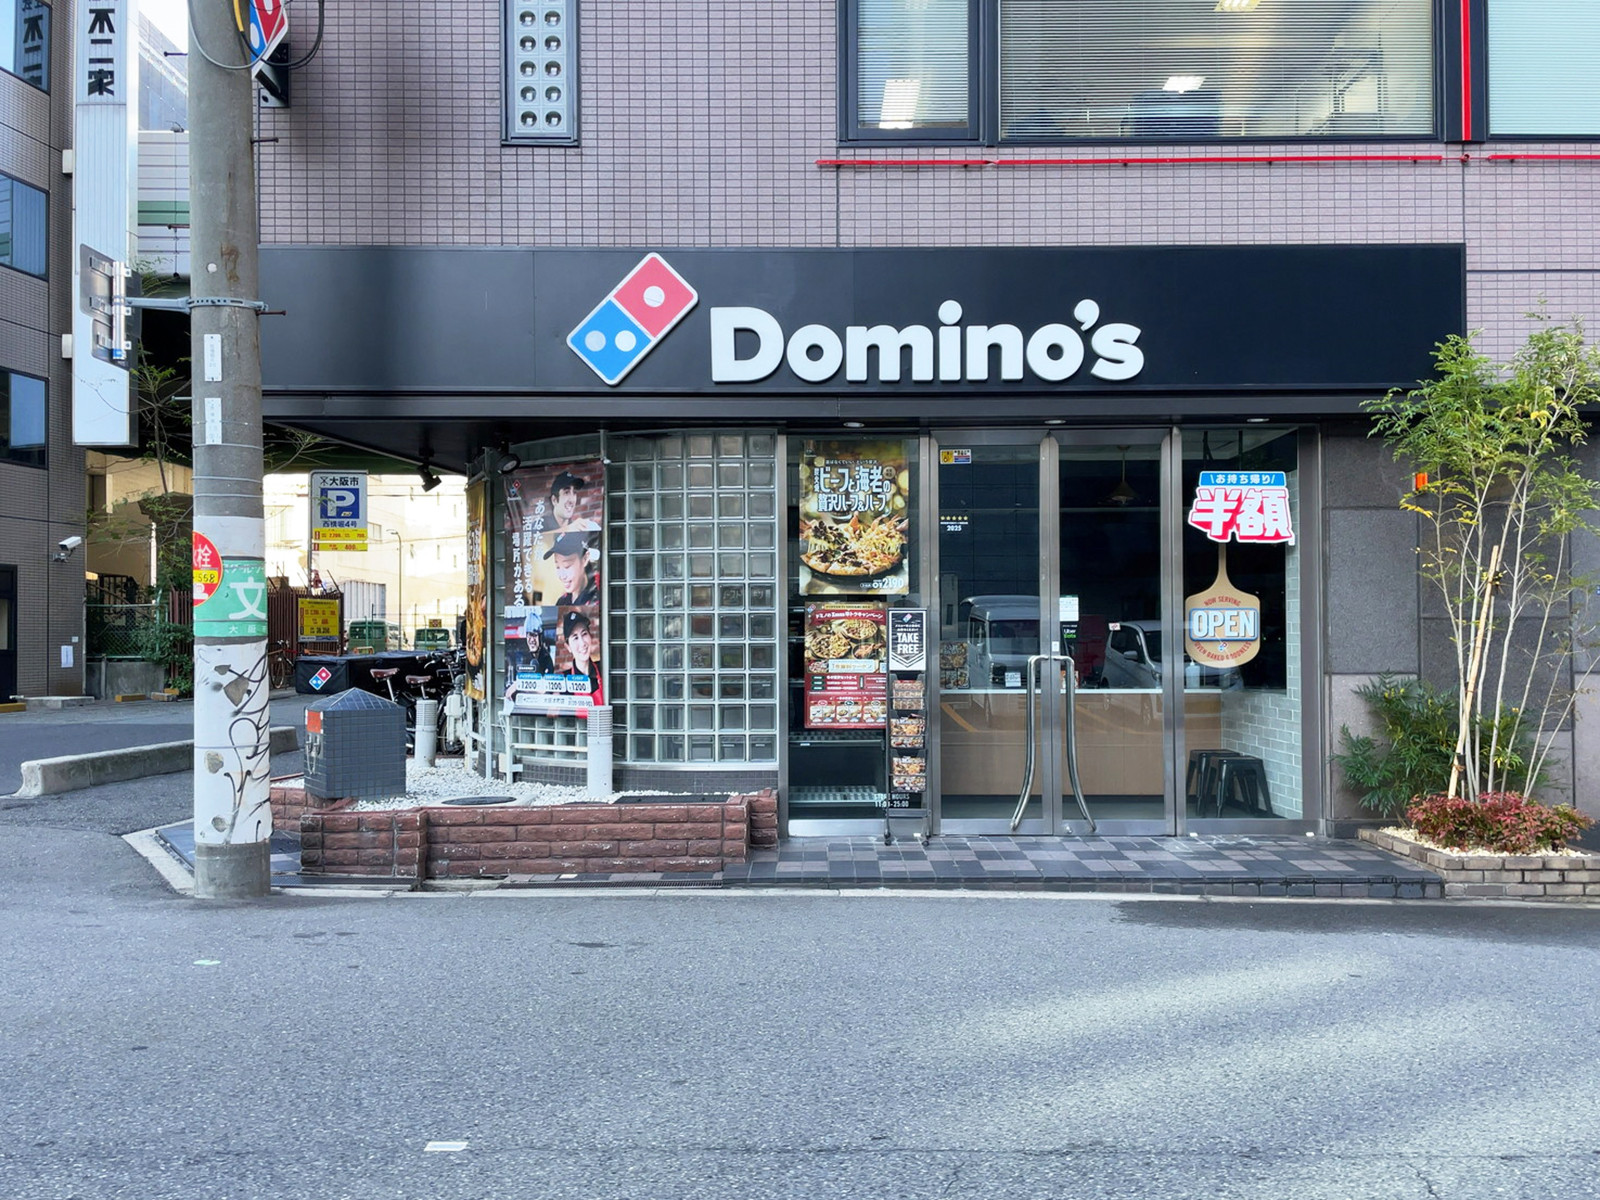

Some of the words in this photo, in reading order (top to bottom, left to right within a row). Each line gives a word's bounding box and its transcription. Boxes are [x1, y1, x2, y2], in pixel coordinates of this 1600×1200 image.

[709, 299, 1145, 383] Domino's
[329, 476, 359, 486] 大阪市
[820, 466, 891, 493] ビーフと海老の
[1215, 474, 1271, 484] お持ち帰り
[327, 490, 356, 517] P
[1191, 488, 1290, 538] 半額
[193, 544, 212, 568] 栓
[229, 577, 266, 620] 文
[1218, 596, 1242, 606] SERVING
[1193, 610, 1256, 638] OPEN
[897, 633, 919, 643] TAKE
[897, 644, 919, 654] FREE
